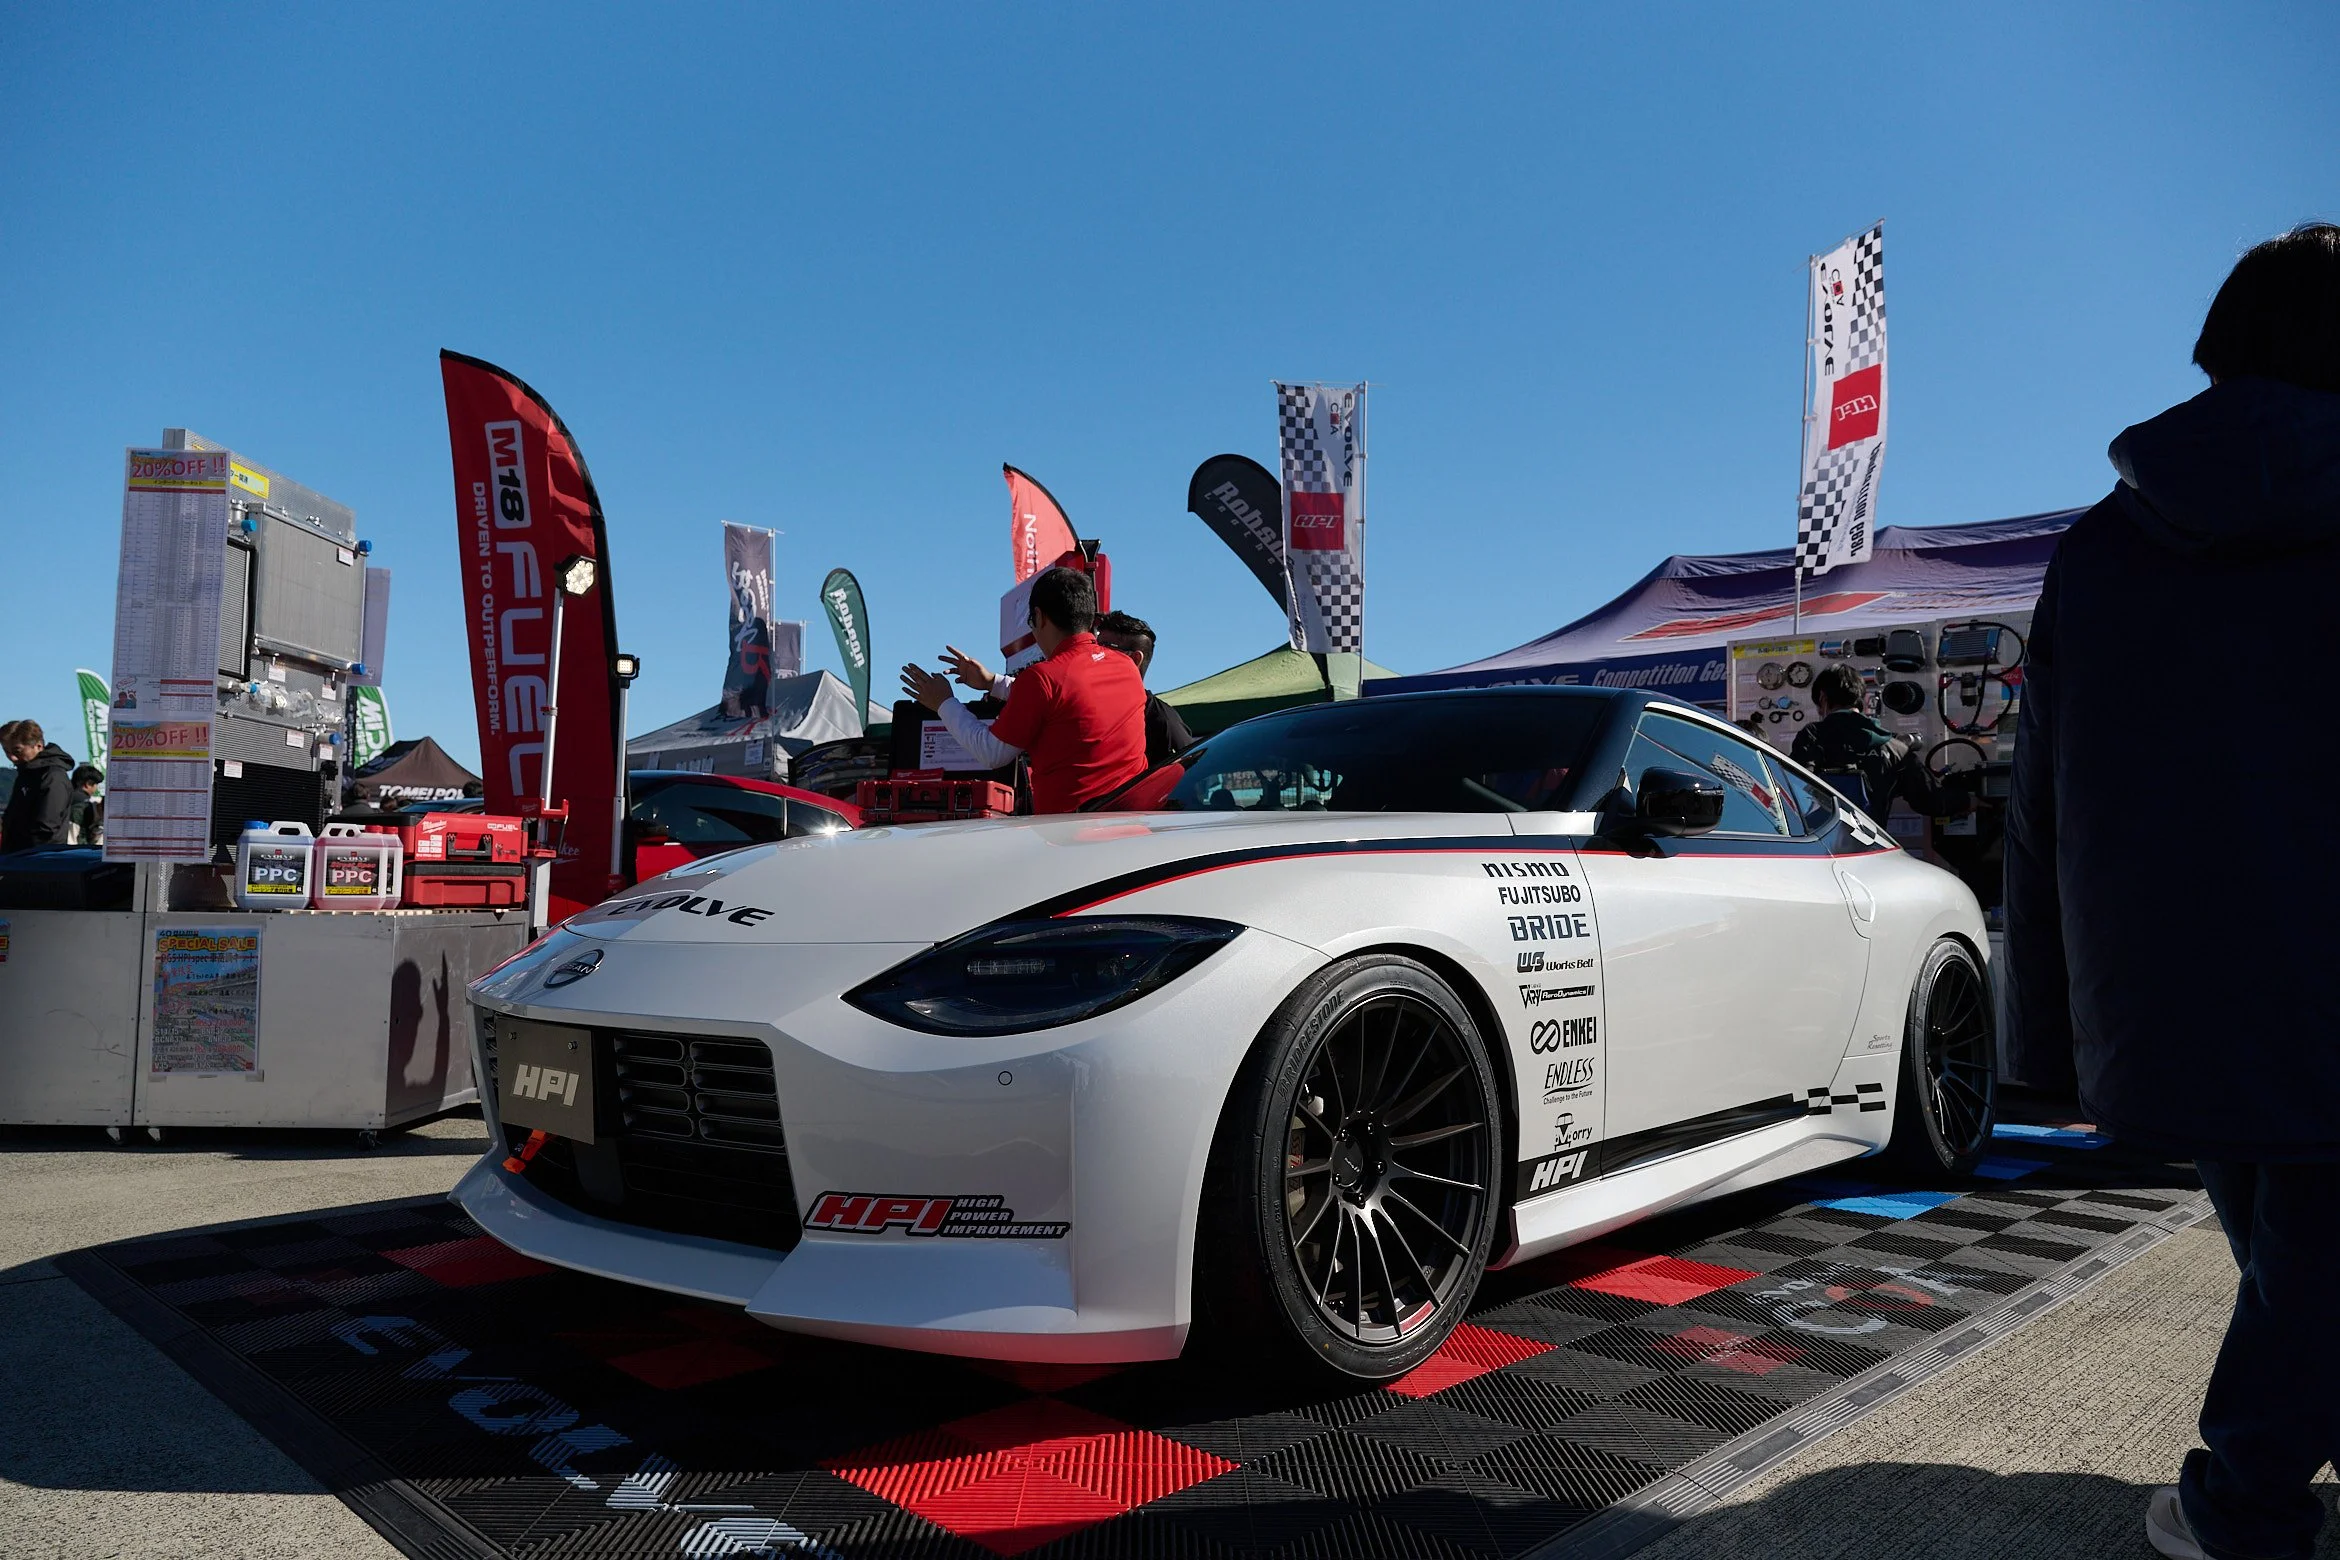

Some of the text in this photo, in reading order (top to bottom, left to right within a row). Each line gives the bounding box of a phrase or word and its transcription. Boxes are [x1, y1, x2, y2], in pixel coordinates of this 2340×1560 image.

[1343, 392, 1353, 487] EVOLVE
[1212, 481, 1285, 565] Robso
[1294, 514, 1340, 528] HPI
[472, 482, 500, 735] DRIVEN TO OUTPERFORM.
[491, 428, 546, 796] M18 FUEL
[1591, 660, 1727, 688] Competition Gea
[379, 785, 432, 800] TOMEI
[255, 866, 297, 882] PPC
[331, 869, 372, 883] PPC
[1498, 885, 1581, 905] FUJITSUBO
[607, 895, 775, 927] EVOLVE
[1507, 913, 1590, 941] BRIDE
[159, 937, 257, 951] SPECIAL SALE
[1546, 960, 1575, 971] Works
[1577, 958, 1593, 969] Bell
[1277, 989, 1345, 1103] BRIDGESTONE
[1562, 1016, 1597, 1048] ENKEI
[512, 1064, 580, 1107] HPI
[1544, 1057, 1595, 1089] ENDLESS
[1543, 1090, 1593, 1105] Challenge to the Future
[1529, 1150, 1588, 1192] HPI
[805, 1194, 954, 1233] HPI
[950, 1211, 1010, 1221] POWER
[955, 1198, 1000, 1208] HIGH
[942, 1225, 1067, 1235] IMPROVEMENT
